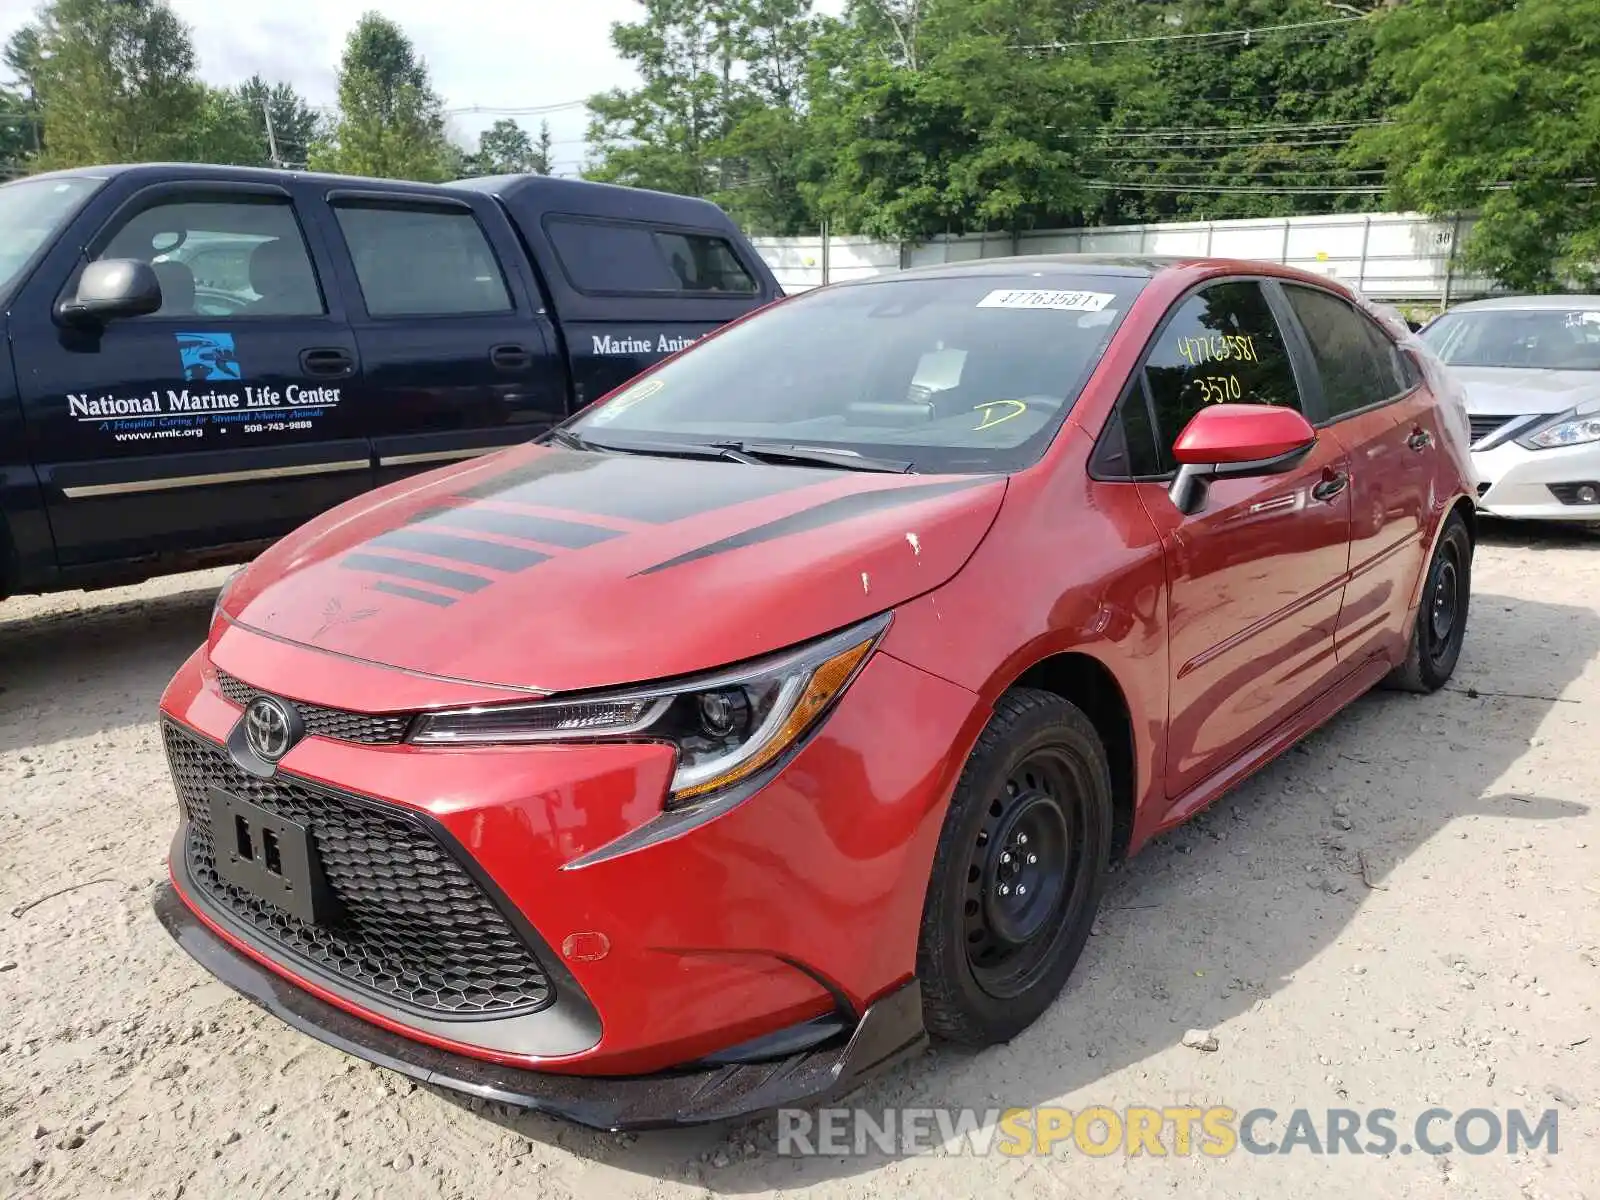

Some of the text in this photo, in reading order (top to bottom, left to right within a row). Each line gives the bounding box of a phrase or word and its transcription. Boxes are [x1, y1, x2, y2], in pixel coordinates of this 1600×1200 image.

[592, 333, 708, 355] Marine Anim
[1177, 335, 1260, 365] 47763581
[66, 384, 340, 417] National Marine Life Center
[1194, 375, 1241, 404] 3570
[114, 418, 156, 430] Hospital
[115, 420, 313, 441] www.nmlc.org 508-743-9888
